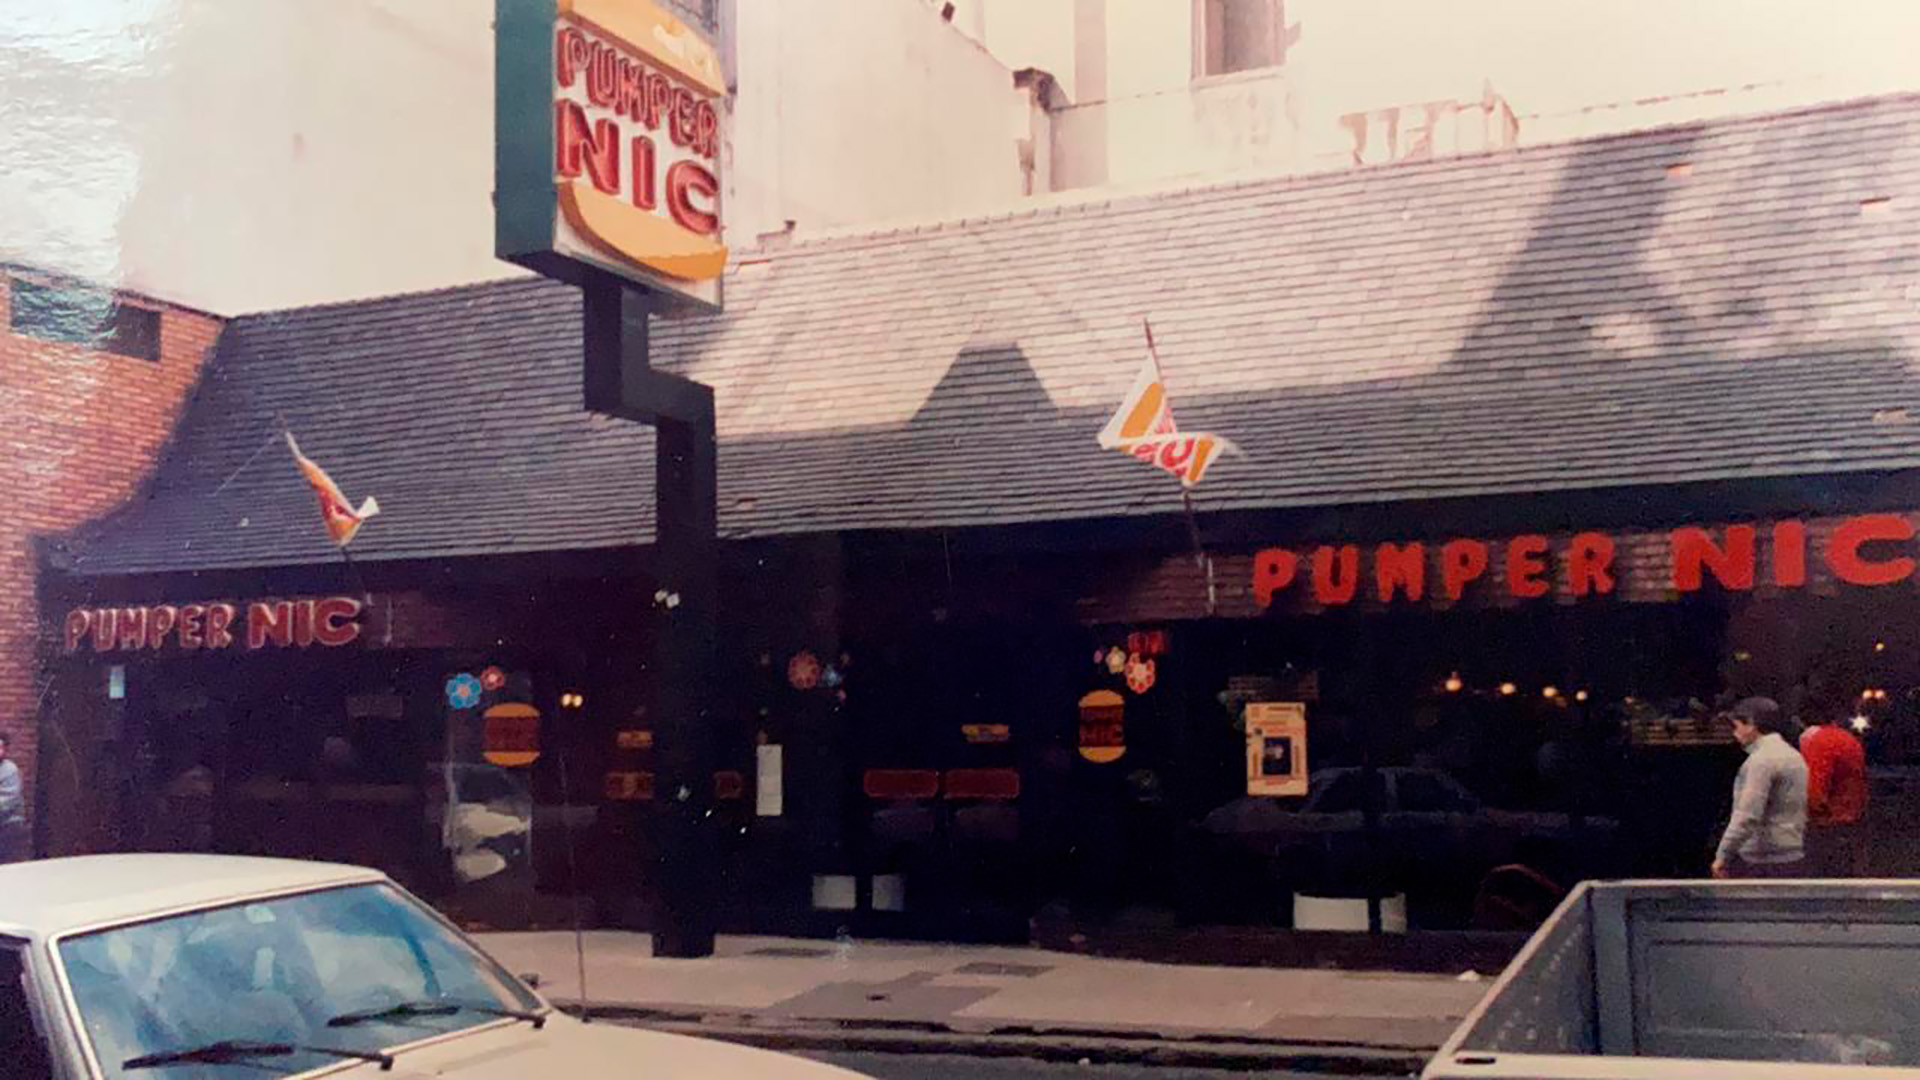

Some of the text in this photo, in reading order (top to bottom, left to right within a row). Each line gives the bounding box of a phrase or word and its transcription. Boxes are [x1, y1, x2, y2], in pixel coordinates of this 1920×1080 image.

[556, 27, 718, 159] PUMPER
[556, 98, 719, 235] NIC
[1252, 513, 1916, 608] PUMPER NIC
[64, 597, 361, 651] PUMPER NIC
